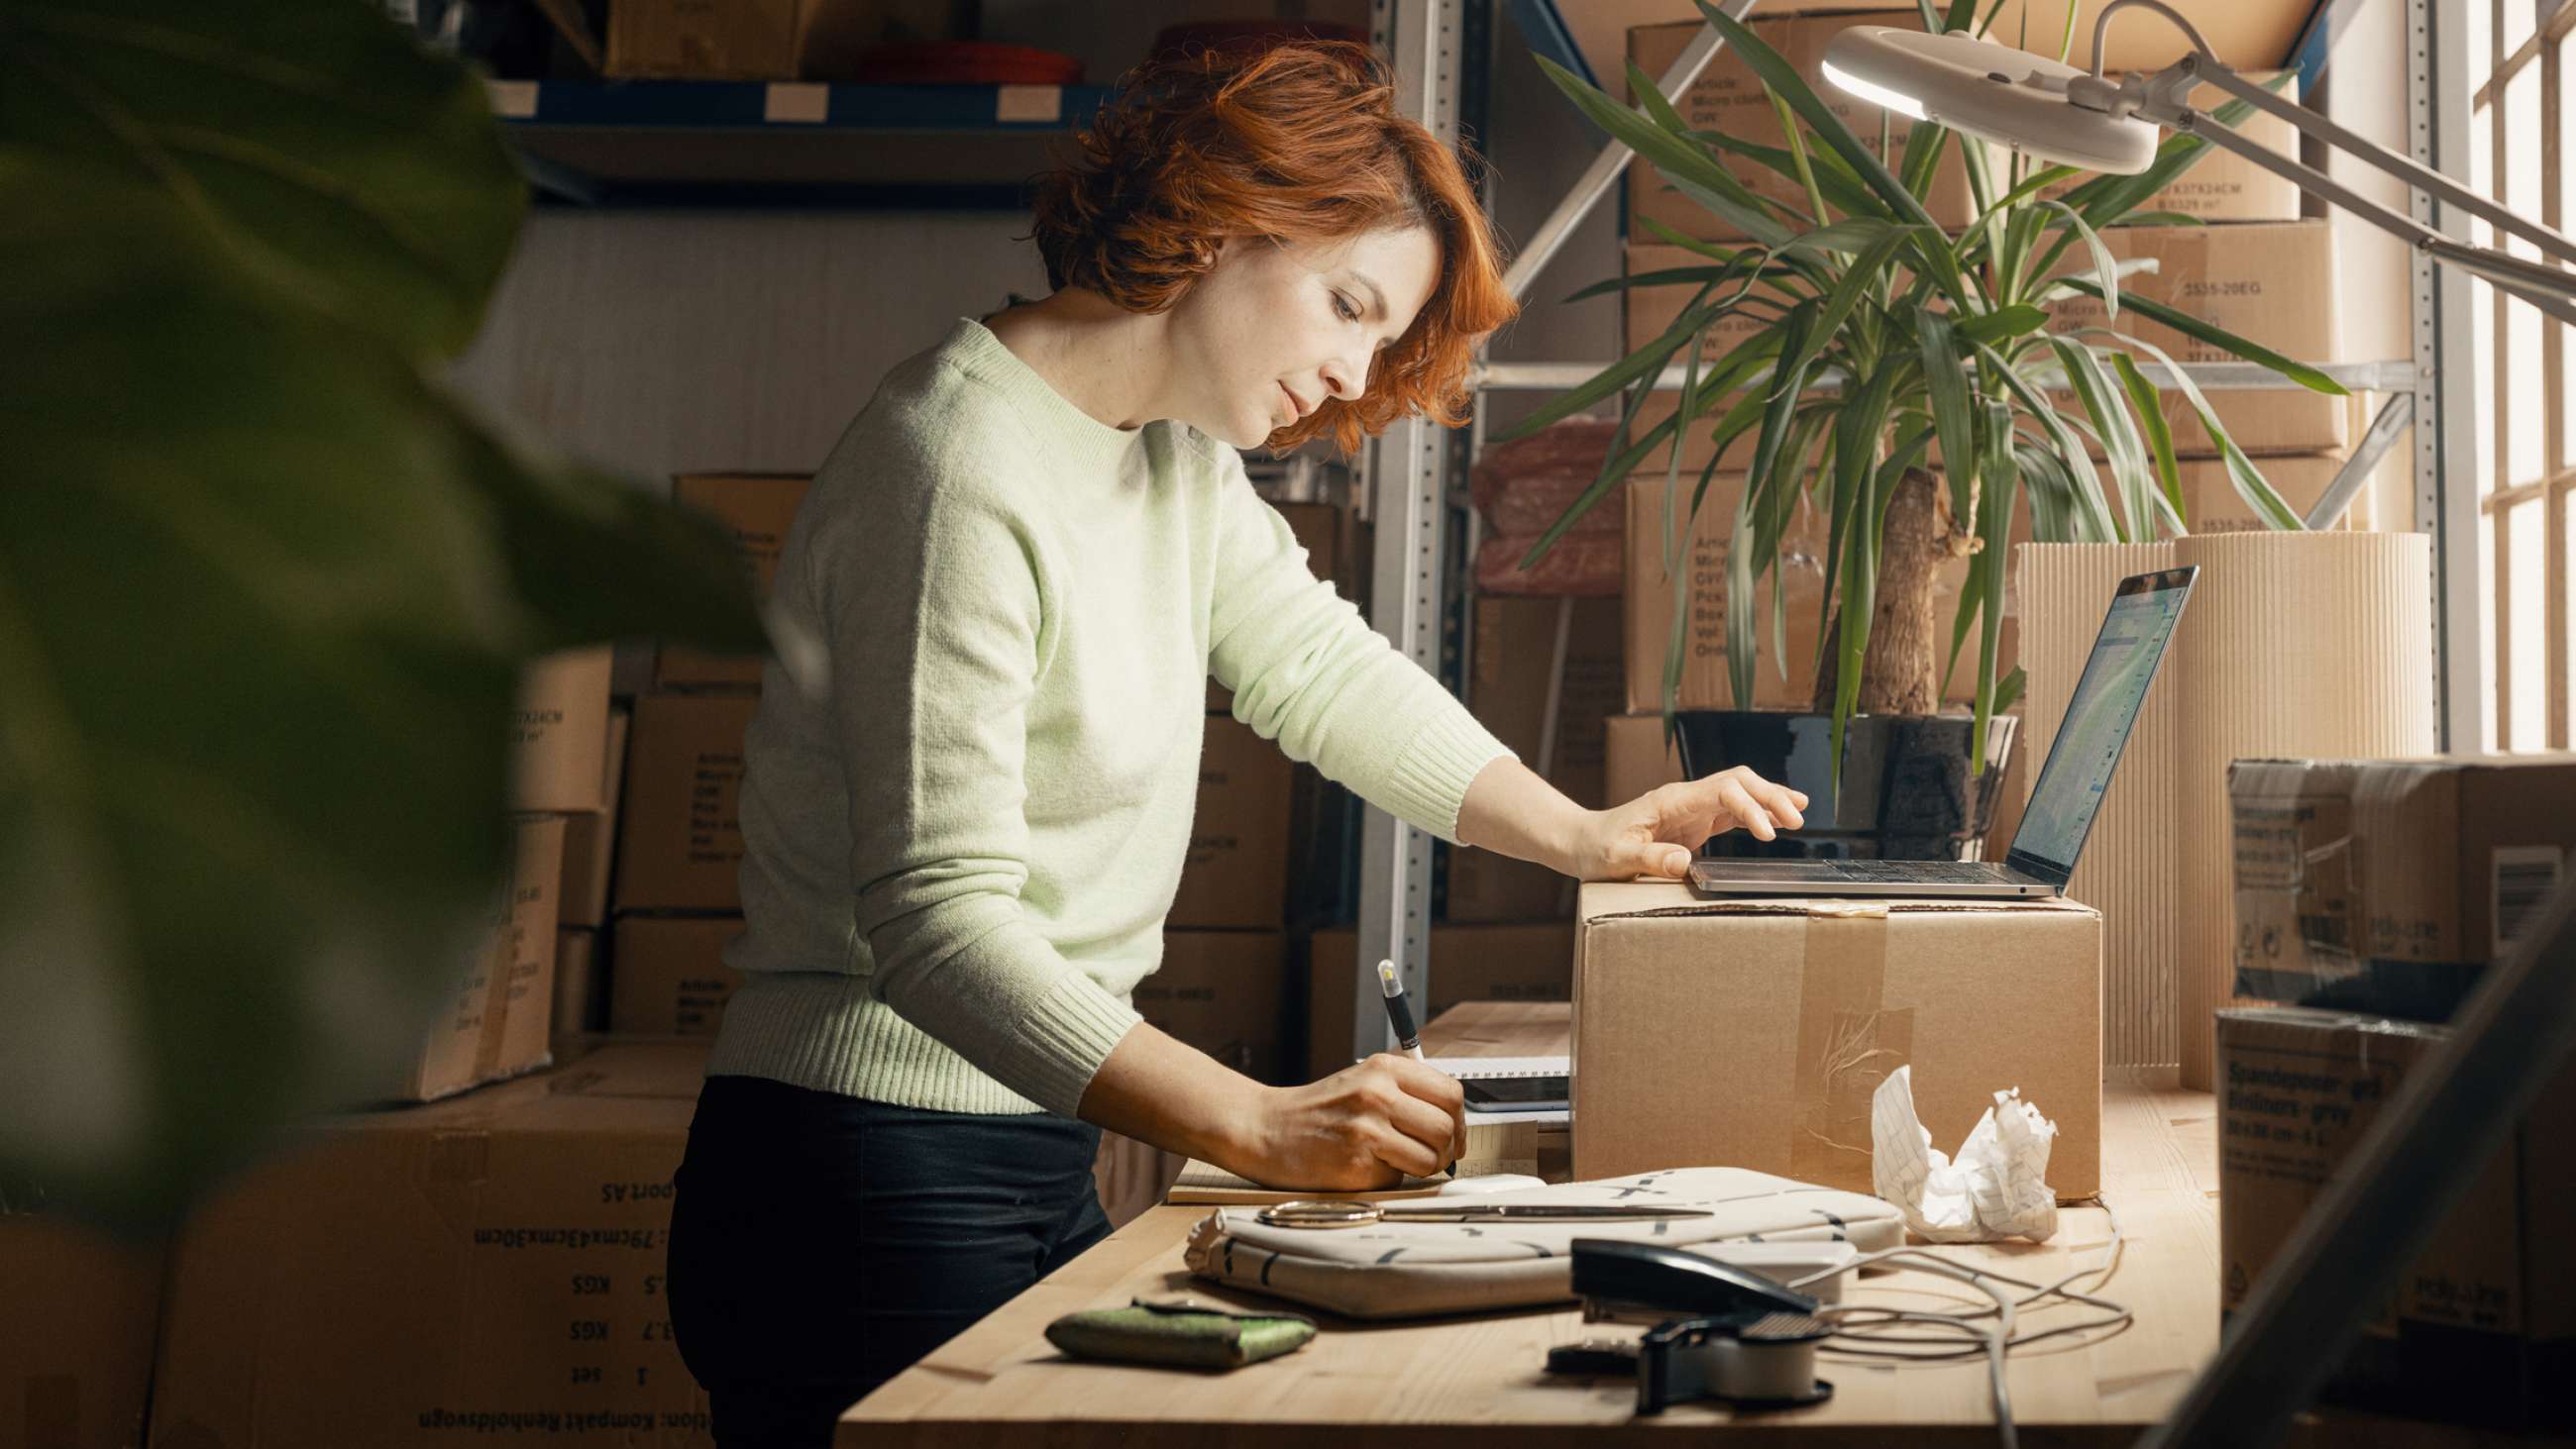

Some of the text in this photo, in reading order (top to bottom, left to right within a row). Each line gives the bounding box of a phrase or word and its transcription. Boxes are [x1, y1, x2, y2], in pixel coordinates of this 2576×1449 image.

[2058, 303, 2097, 316] Micro
[601, 1181, 674, 1204] port AS
[474, 1228, 655, 1249] 79cmx43cmx30cm
[572, 1275, 610, 1295] KGS
[570, 1320, 609, 1342] KGS
[571, 1367, 648, 1387] 1 set
[418, 1407, 713, 1433] tion: Kompakt Renholdsvogn
